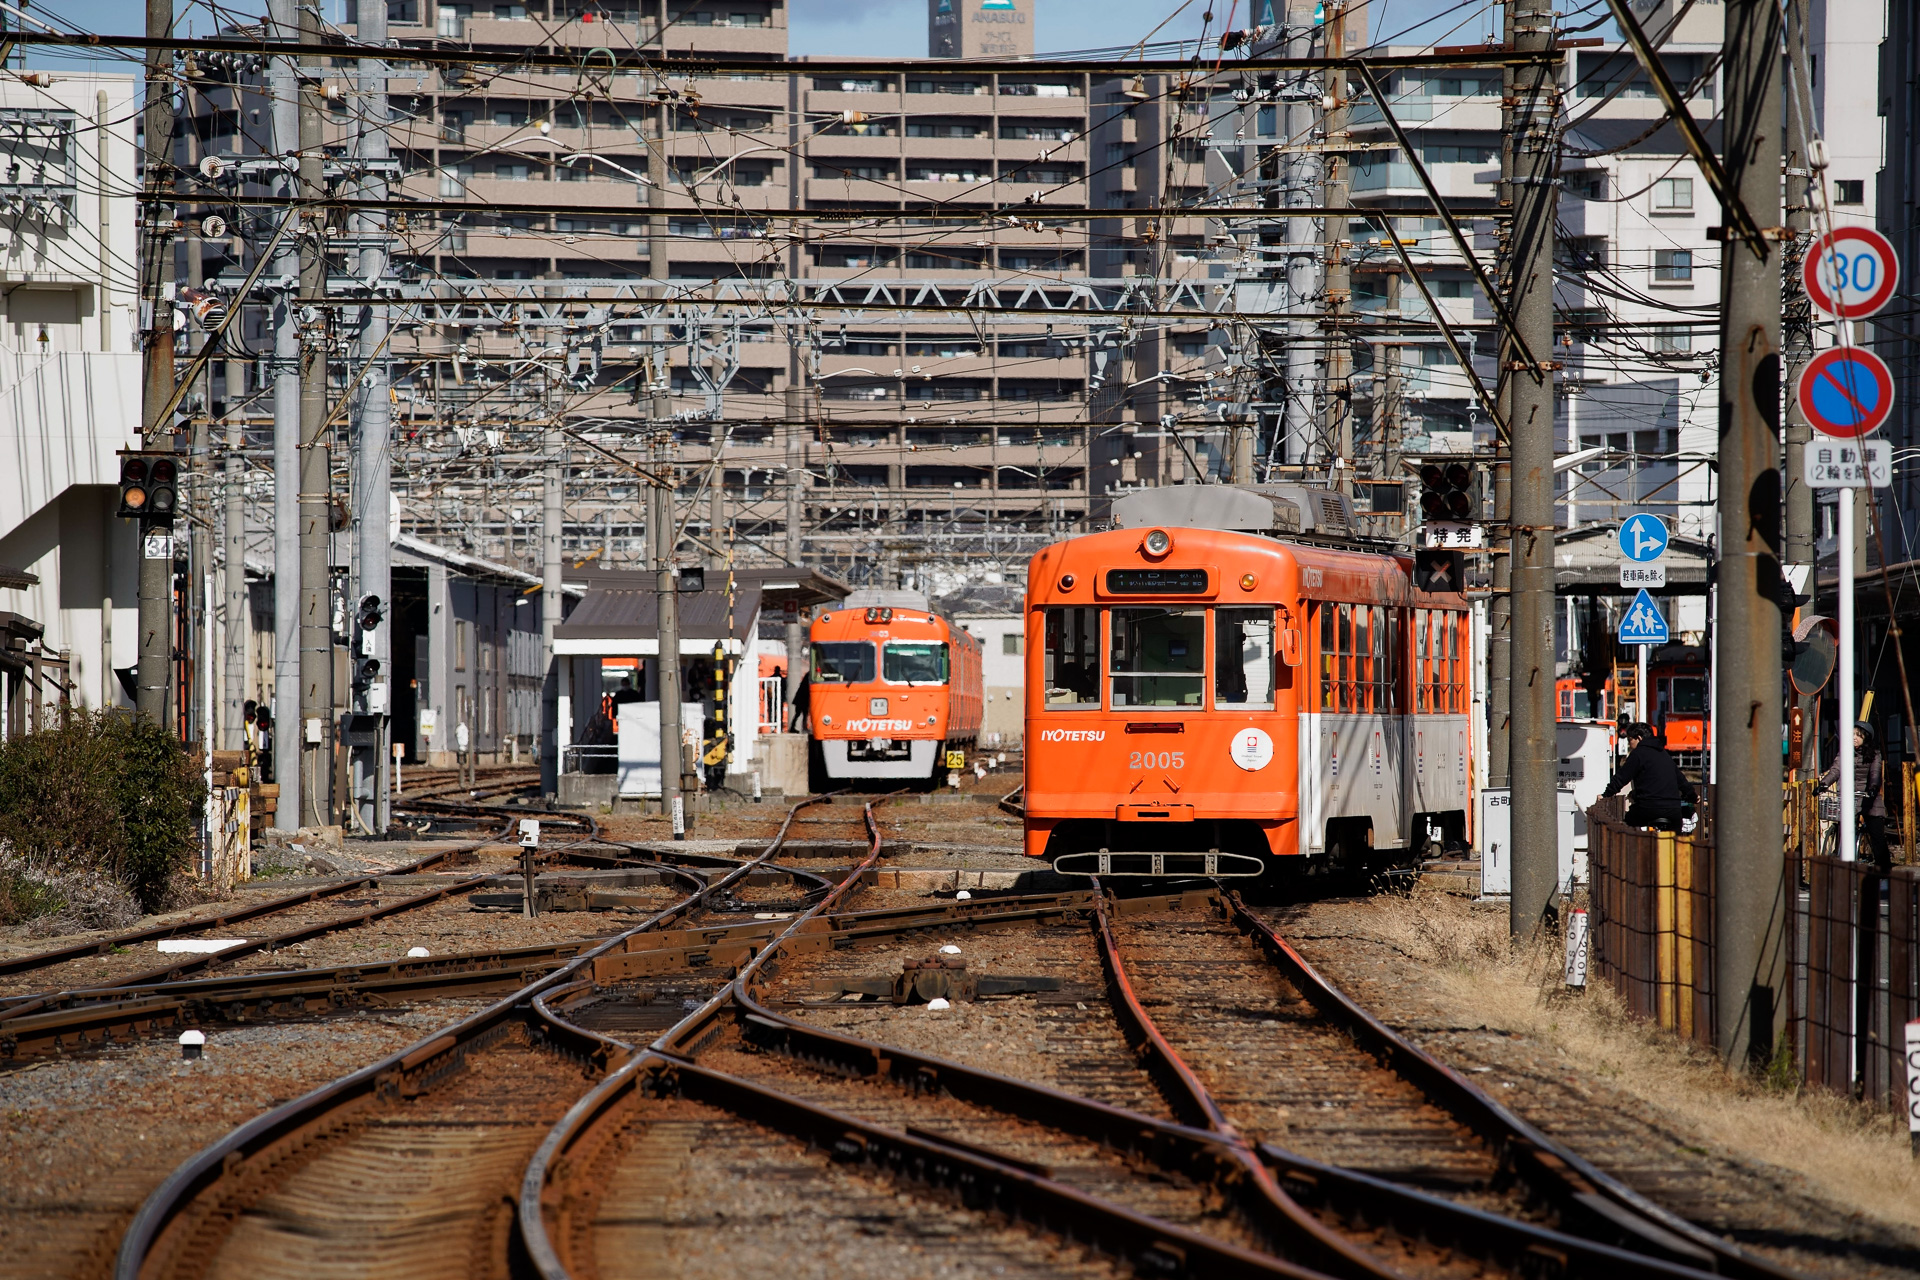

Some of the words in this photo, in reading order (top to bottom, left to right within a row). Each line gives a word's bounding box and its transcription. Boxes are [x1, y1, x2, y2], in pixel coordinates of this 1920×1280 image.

[1826, 253, 1876, 291] 30
[1819, 448, 1876, 463] 自動車
[1433, 527, 1471, 543] 特発
[149, 539, 171, 557] 34
[1622, 570, 1663, 581] 軽車両を除く
[846, 718, 912, 732] IYOTETSU
[1041, 729, 1106, 742] IYOTETSU
[948, 752, 963, 766] 25
[1129, 751, 1185, 769] 2005
